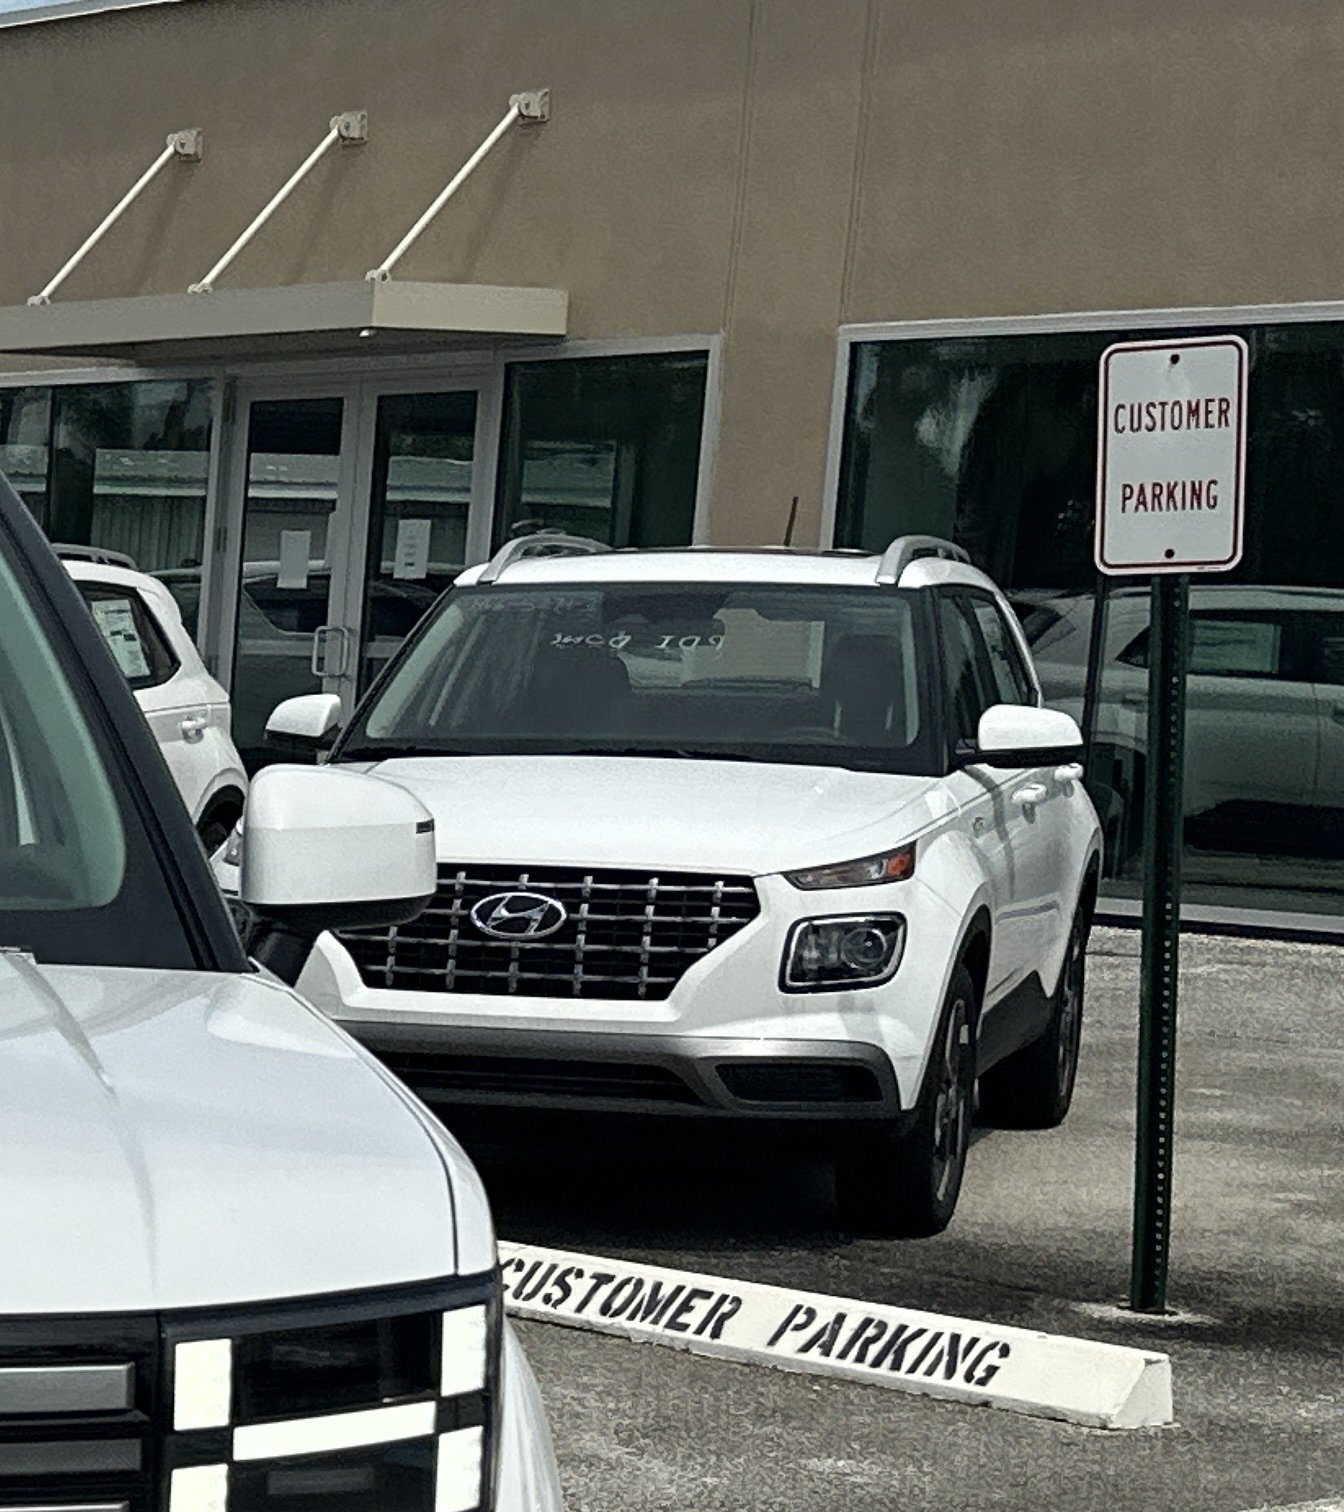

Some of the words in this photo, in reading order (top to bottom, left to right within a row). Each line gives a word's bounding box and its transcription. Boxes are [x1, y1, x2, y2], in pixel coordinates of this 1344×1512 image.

[1113, 397, 1231, 434] CUSTOMER
[1121, 478, 1219, 514] PARKING
[499, 1257, 742, 1340] CUSTOMER
[766, 1303, 1010, 1387] PARKING
